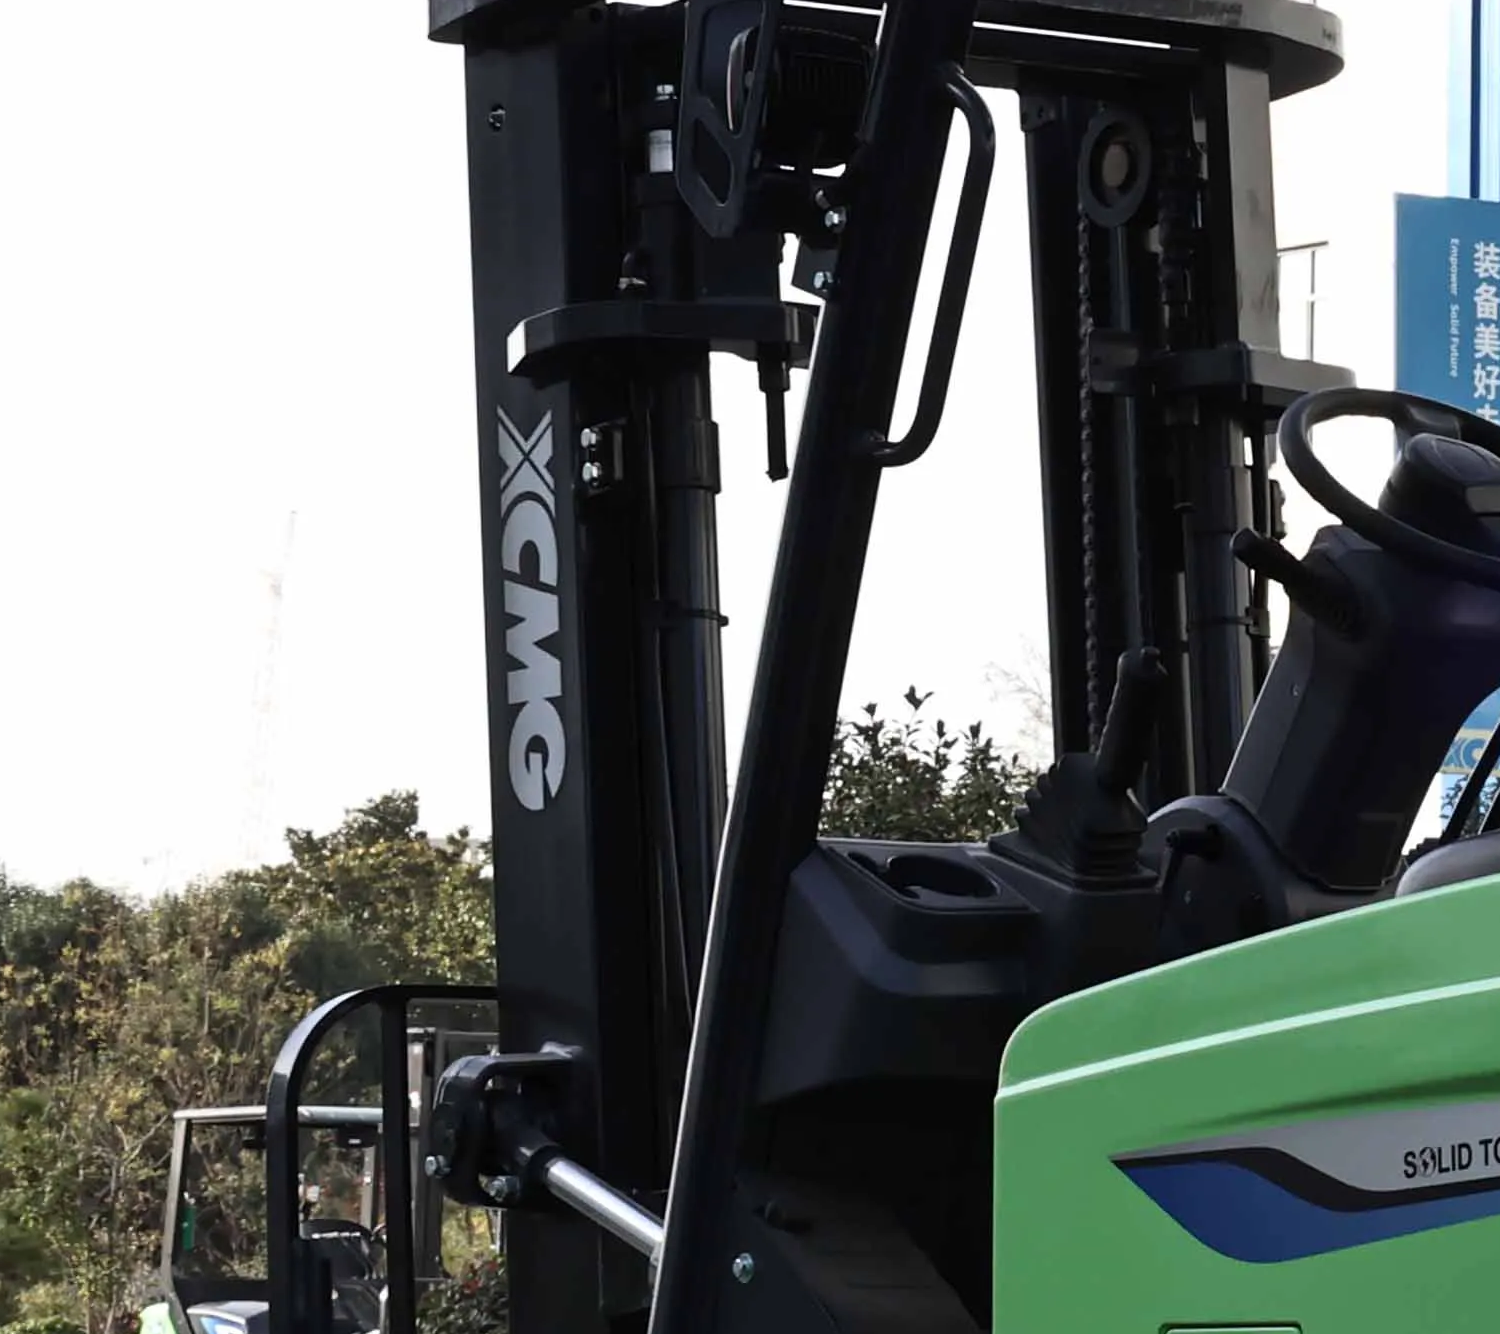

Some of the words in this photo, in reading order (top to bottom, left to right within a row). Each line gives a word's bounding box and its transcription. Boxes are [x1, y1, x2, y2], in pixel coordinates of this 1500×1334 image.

[1449, 304, 1460, 335] Solid
[1449, 337, 1460, 378] Future
[497, 404, 566, 811] XCMG
